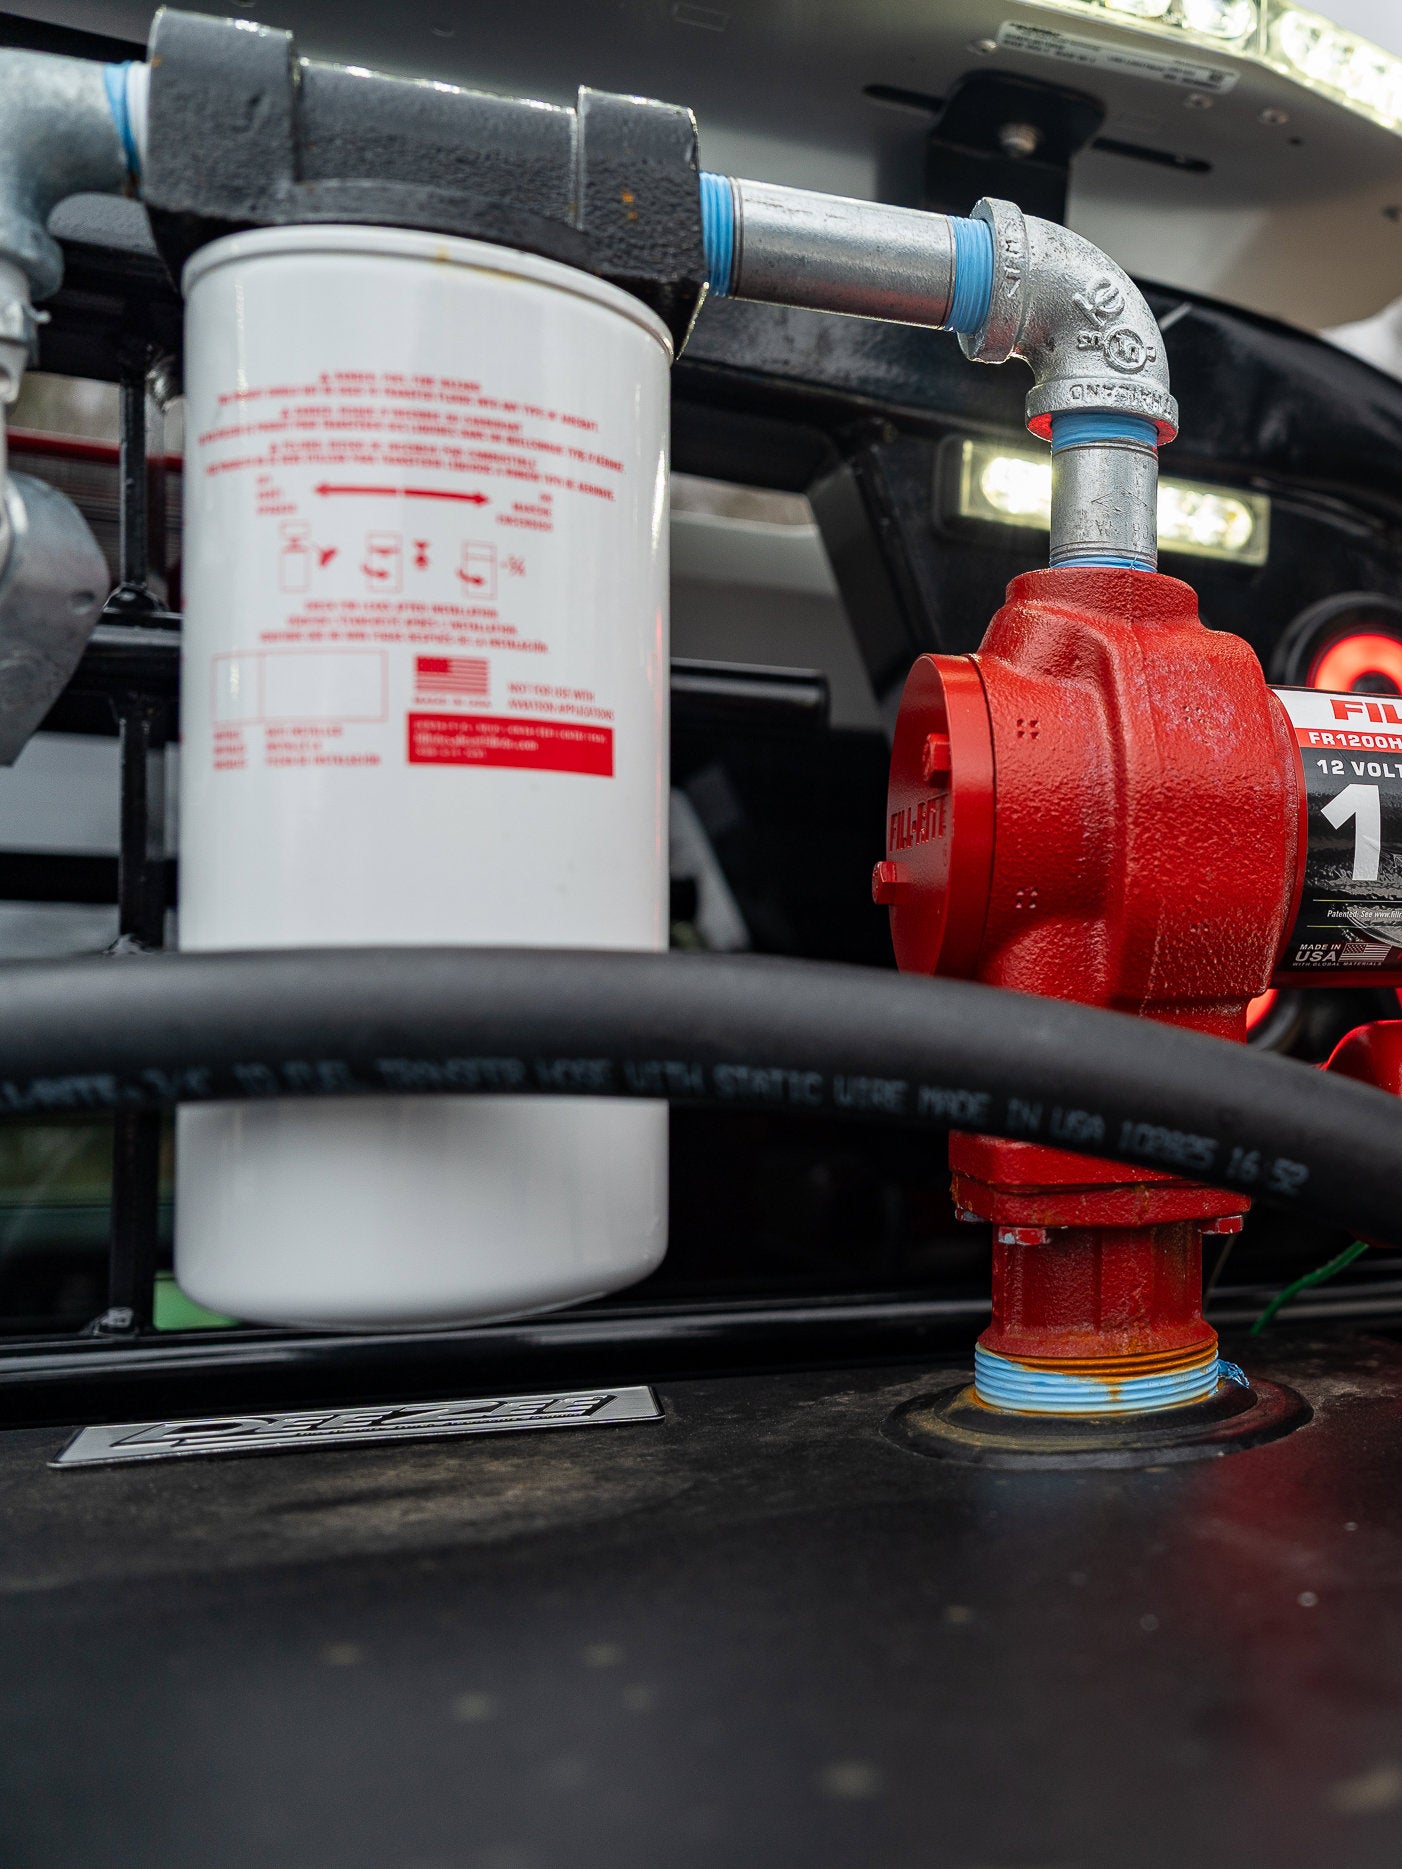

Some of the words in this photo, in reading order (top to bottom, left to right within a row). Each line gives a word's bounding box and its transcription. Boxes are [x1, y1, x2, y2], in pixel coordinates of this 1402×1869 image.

[1309, 732, 1402, 750] FR1200H
[1316, 759, 1345, 775] 12
[889, 793, 948, 855] FILL-RITE
[1327, 909, 1359, 918] Patented:
[1361, 910, 1372, 918] See
[1295, 951, 1337, 962] USA
[374, 1057, 526, 1088] TRANSFER
[535, 1058, 612, 1089] HOSE
[624, 1060, 705, 1094] WITH
[713, 1063, 823, 1106] STATIC
[833, 1074, 907, 1116] WIRE
[918, 1084, 992, 1125] MADE
[1006, 1097, 1042, 1133] IN
[1050, 1106, 1105, 1143] USA
